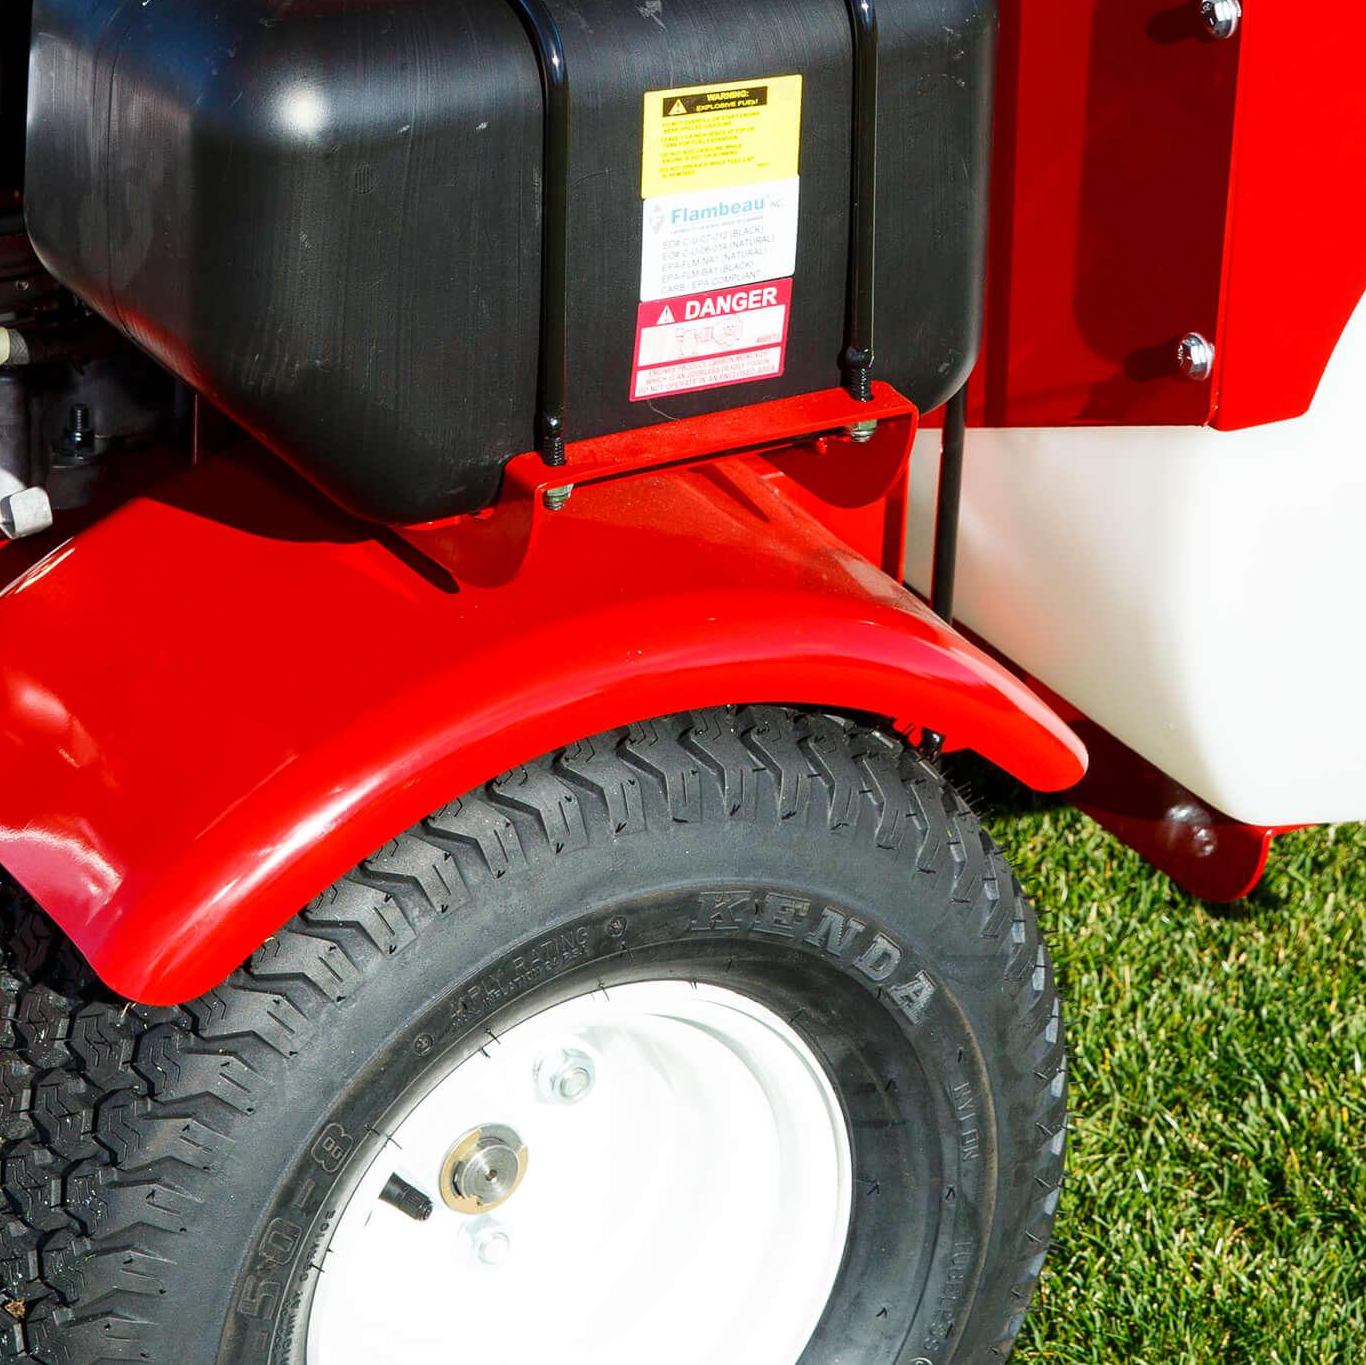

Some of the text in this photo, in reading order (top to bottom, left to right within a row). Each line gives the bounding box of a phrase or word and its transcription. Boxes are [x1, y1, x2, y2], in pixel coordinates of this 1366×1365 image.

[696, 101, 736, 112] EXPLOSIVE
[707, 90, 749, 101] WARNING:
[671, 198, 764, 225] Flambeau
[685, 287, 777, 320] DANGER
[690, 890, 936, 1025] KENDA
